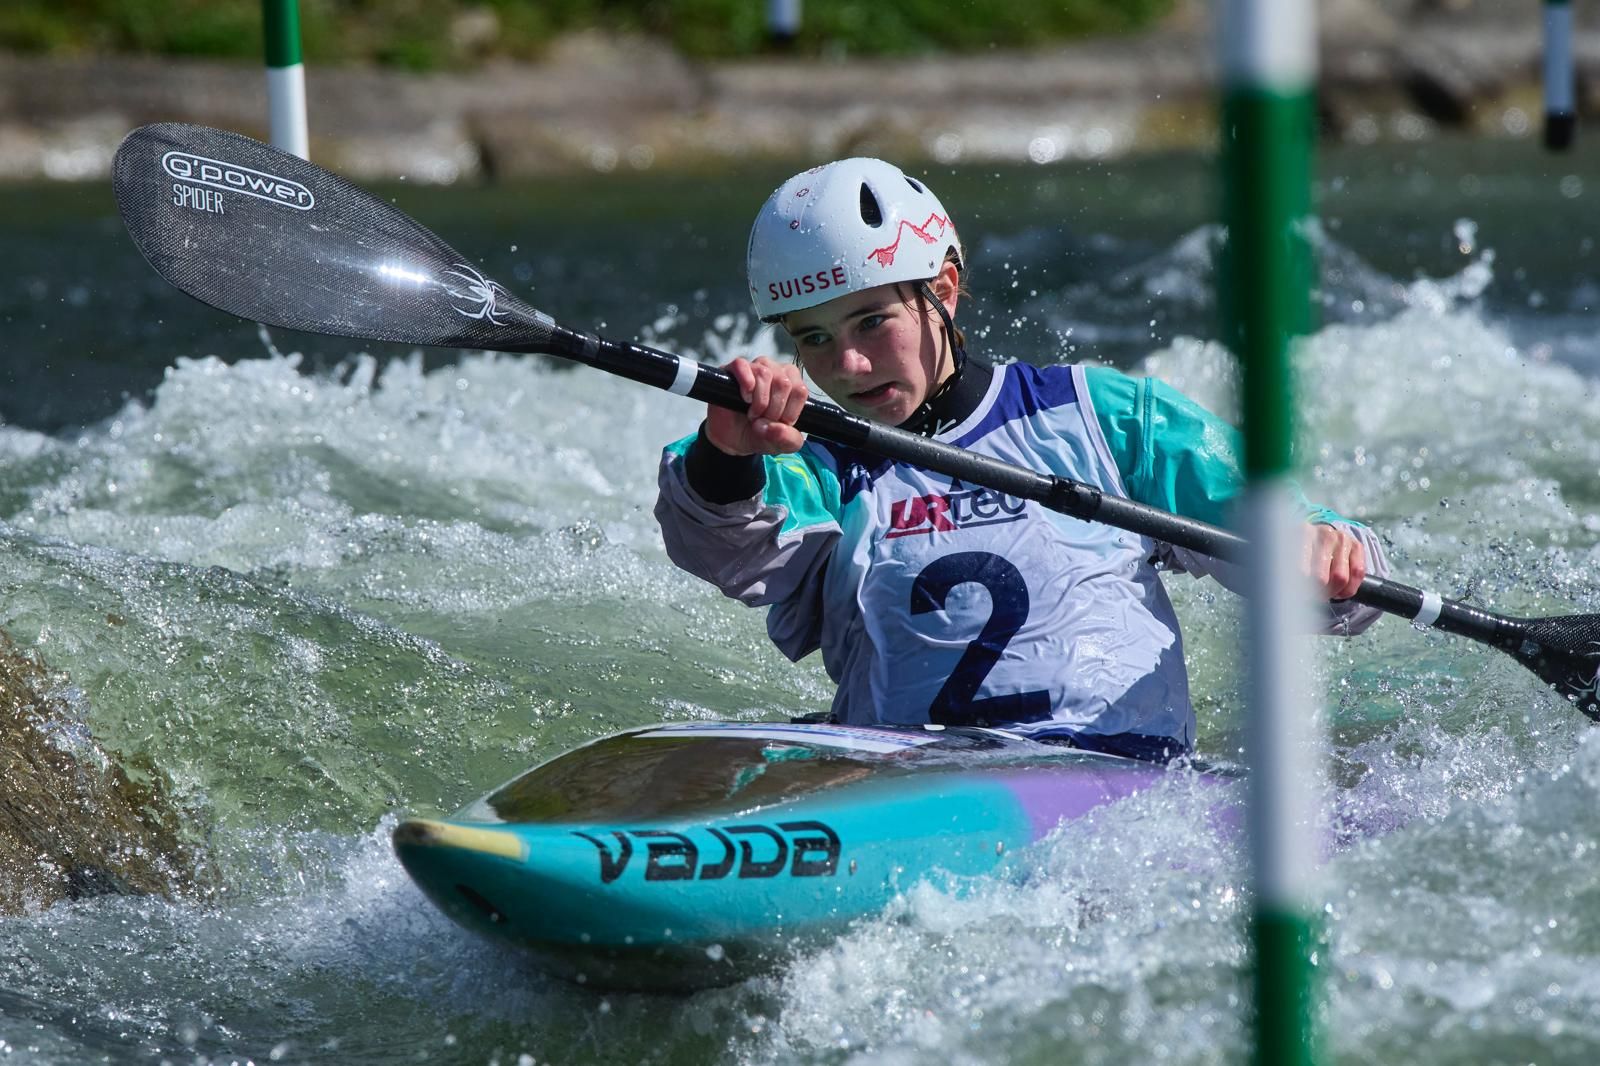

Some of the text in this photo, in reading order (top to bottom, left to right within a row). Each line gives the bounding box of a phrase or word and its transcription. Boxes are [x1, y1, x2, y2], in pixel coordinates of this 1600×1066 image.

[172, 183, 225, 215] SPIDER
[768, 266, 847, 301] SUISSE
[910, 551, 1054, 725] 2
